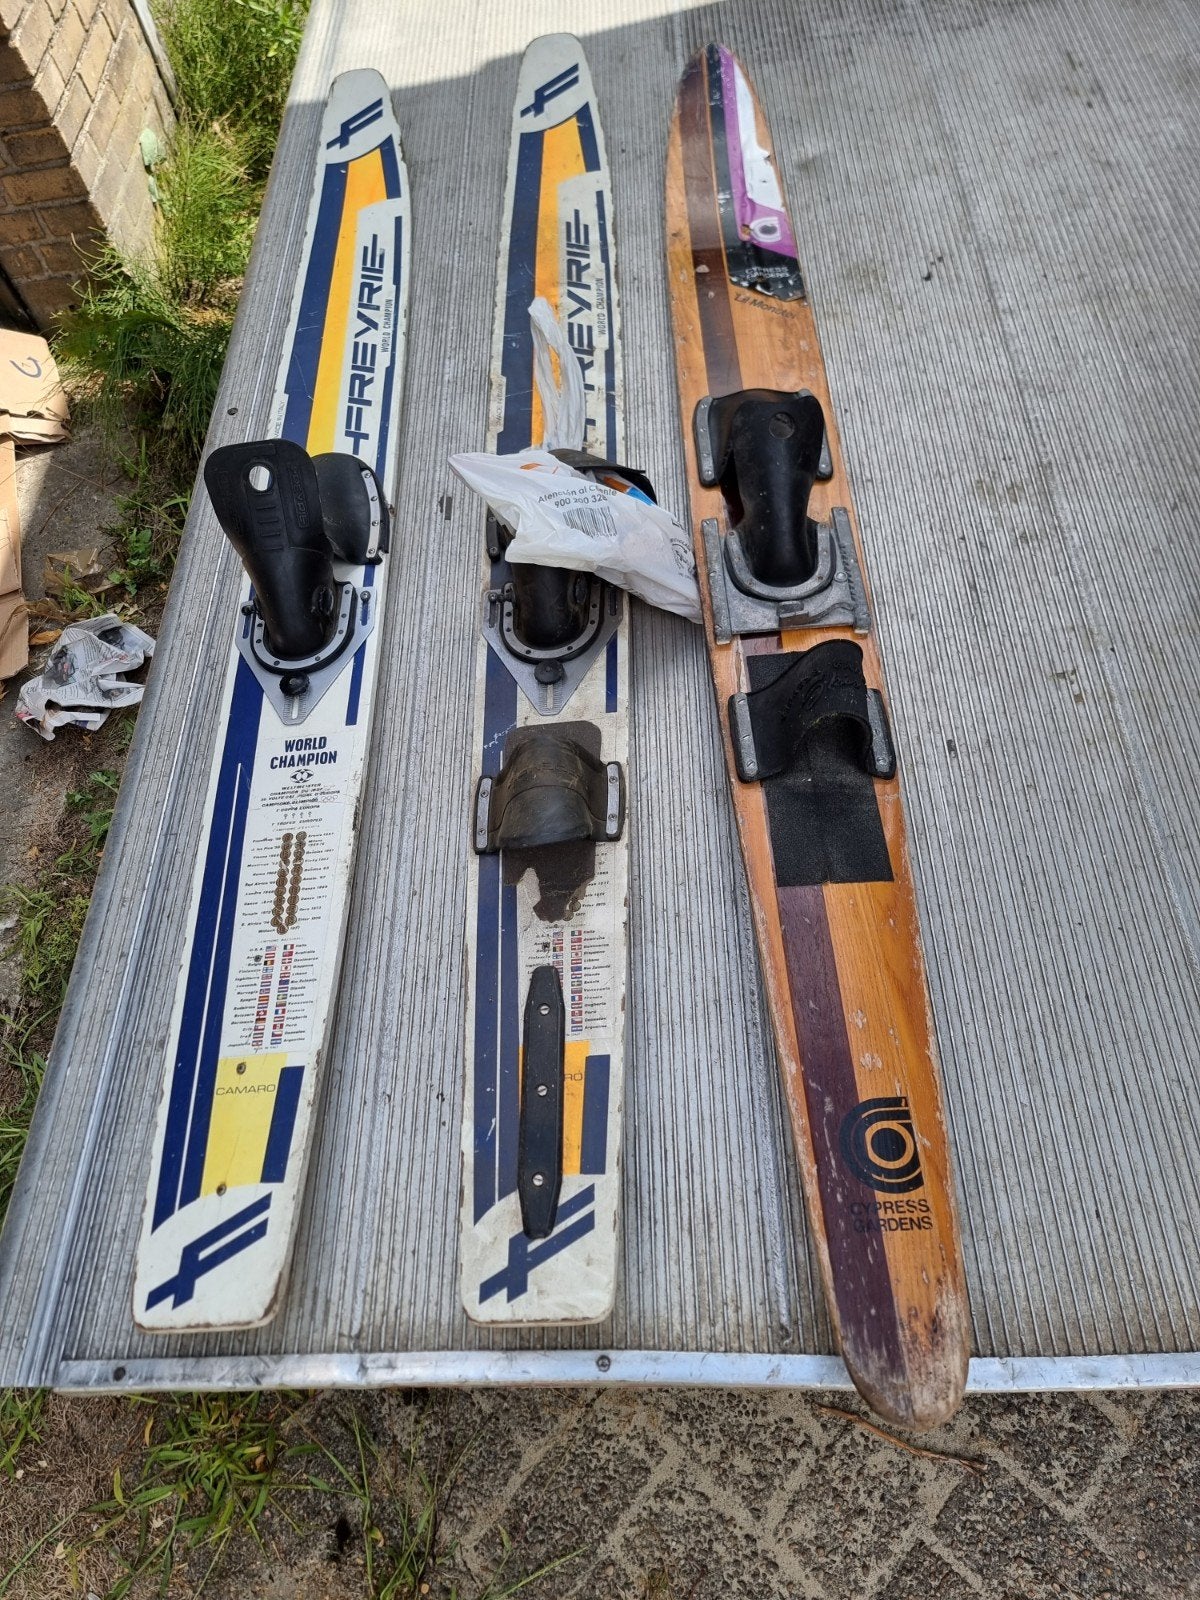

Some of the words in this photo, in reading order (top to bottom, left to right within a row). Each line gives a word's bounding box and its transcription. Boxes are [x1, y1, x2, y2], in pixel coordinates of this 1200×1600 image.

[383, 298, 393, 330] CHAMPION
[566, 208, 597, 450] REYRIE
[345, 233, 386, 456] FREYRIE
[380, 331, 392, 353] WORLD
[554, 497, 571, 508] 900
[284, 736, 327, 753] WORLD
[270, 750, 337, 769] CHAMPION
[215, 1083, 276, 1096] CAMARO
[851, 1199, 930, 1215] CYPRESS
[853, 1216, 933, 1233] GARDENS
